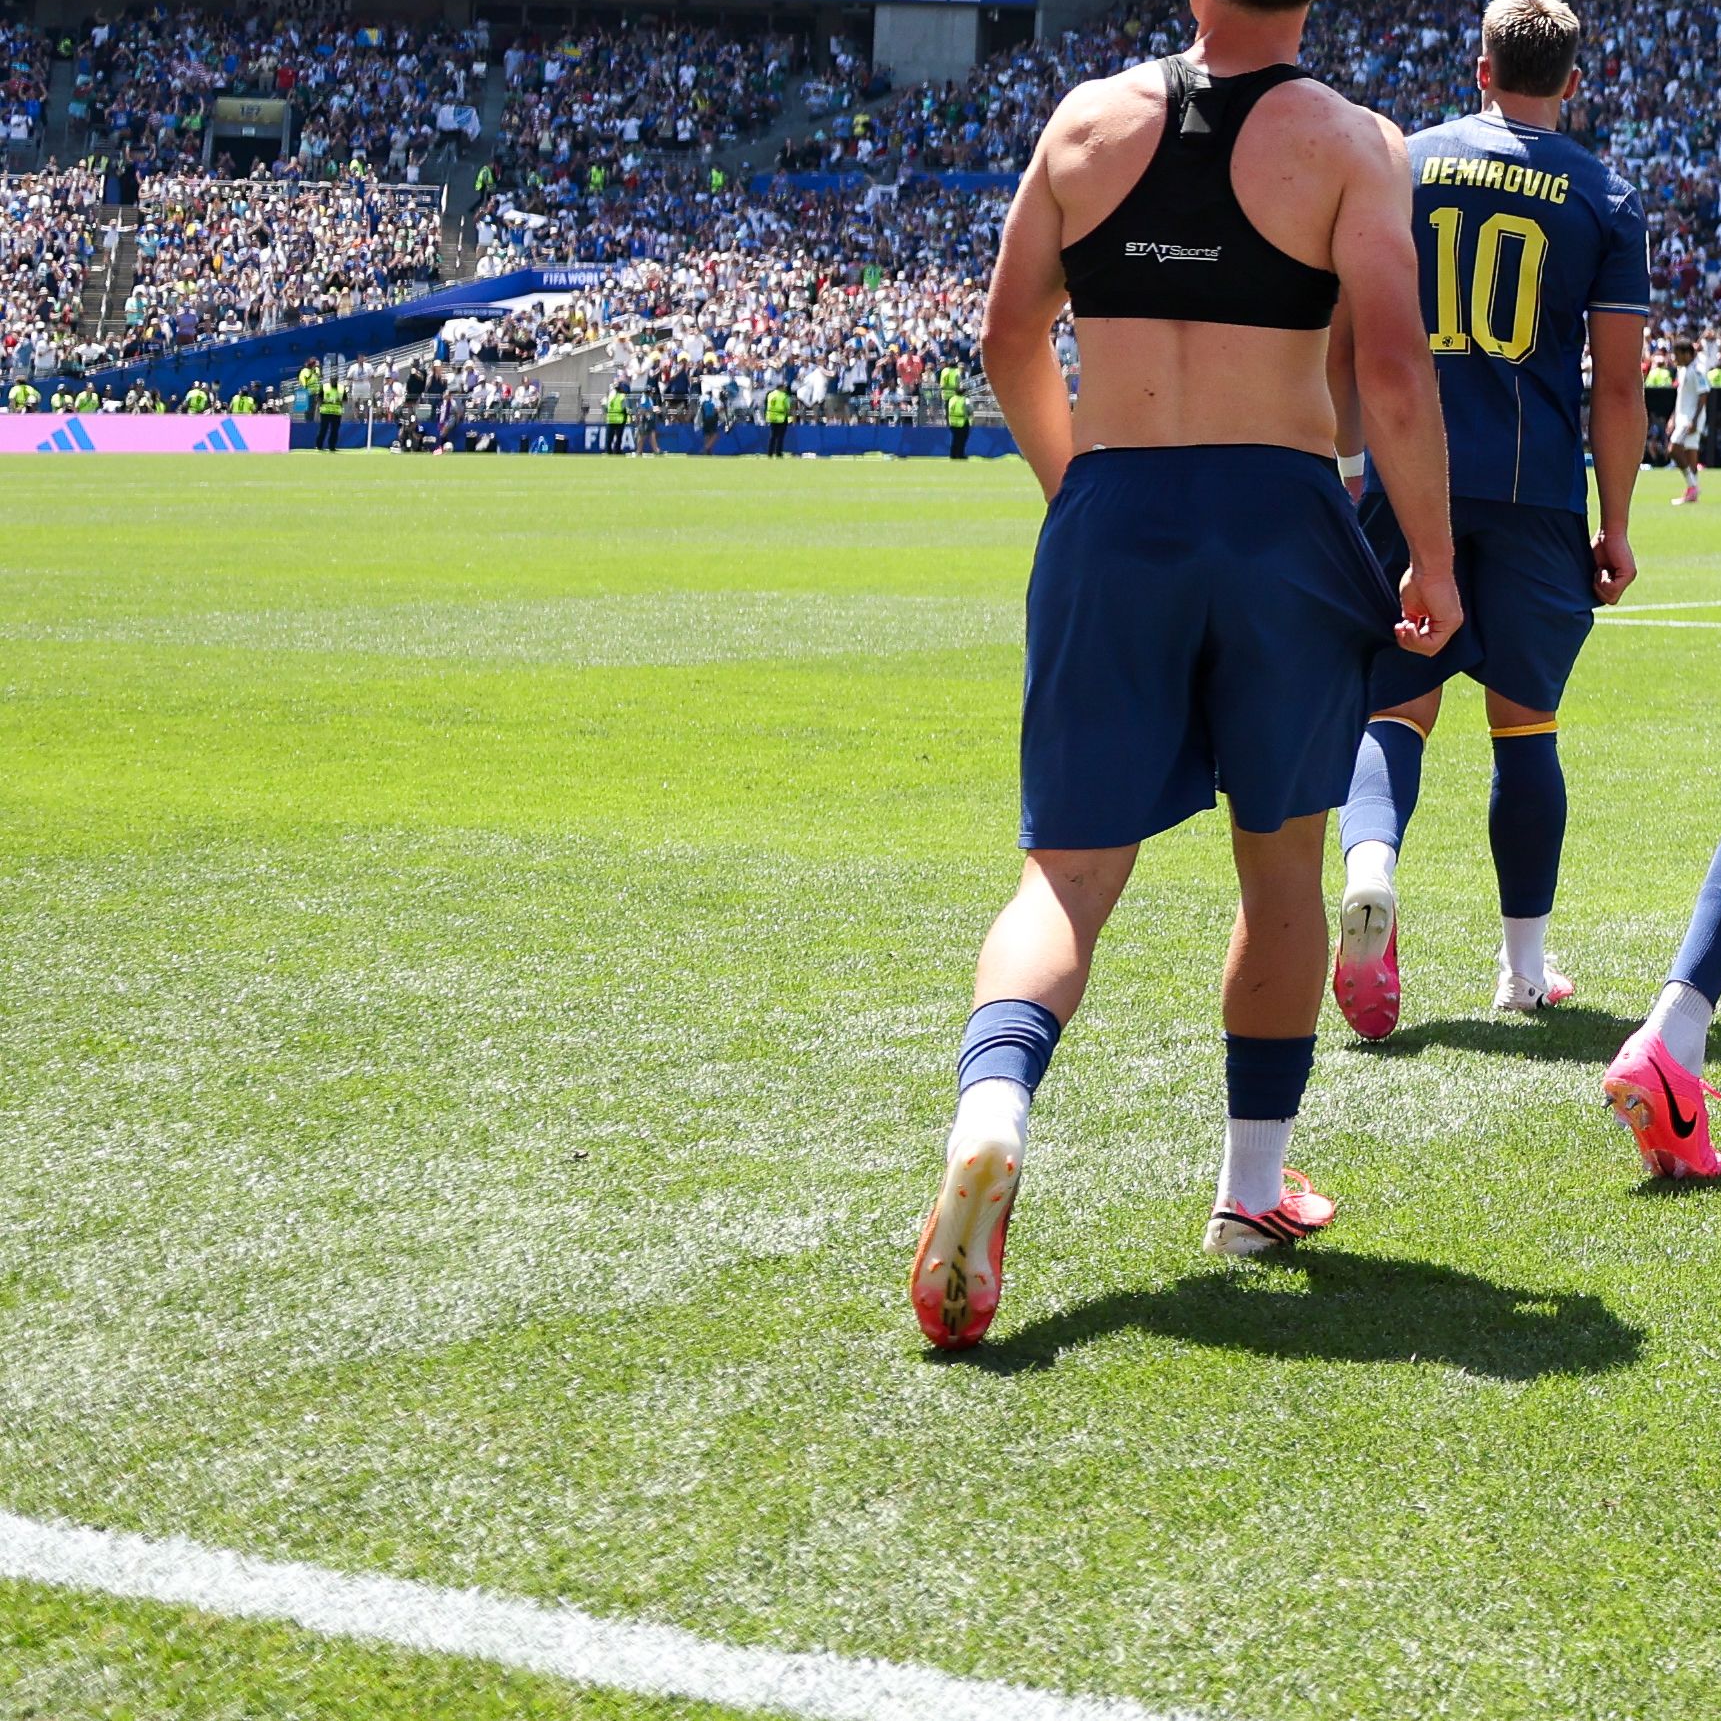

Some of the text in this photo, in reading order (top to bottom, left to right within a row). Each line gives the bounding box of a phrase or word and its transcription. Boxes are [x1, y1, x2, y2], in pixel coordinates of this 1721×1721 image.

[1421, 156, 1569, 205] DEMIROVIĆ
[1429, 207, 1549, 365] 10
[584, 425, 636, 450] FIA
